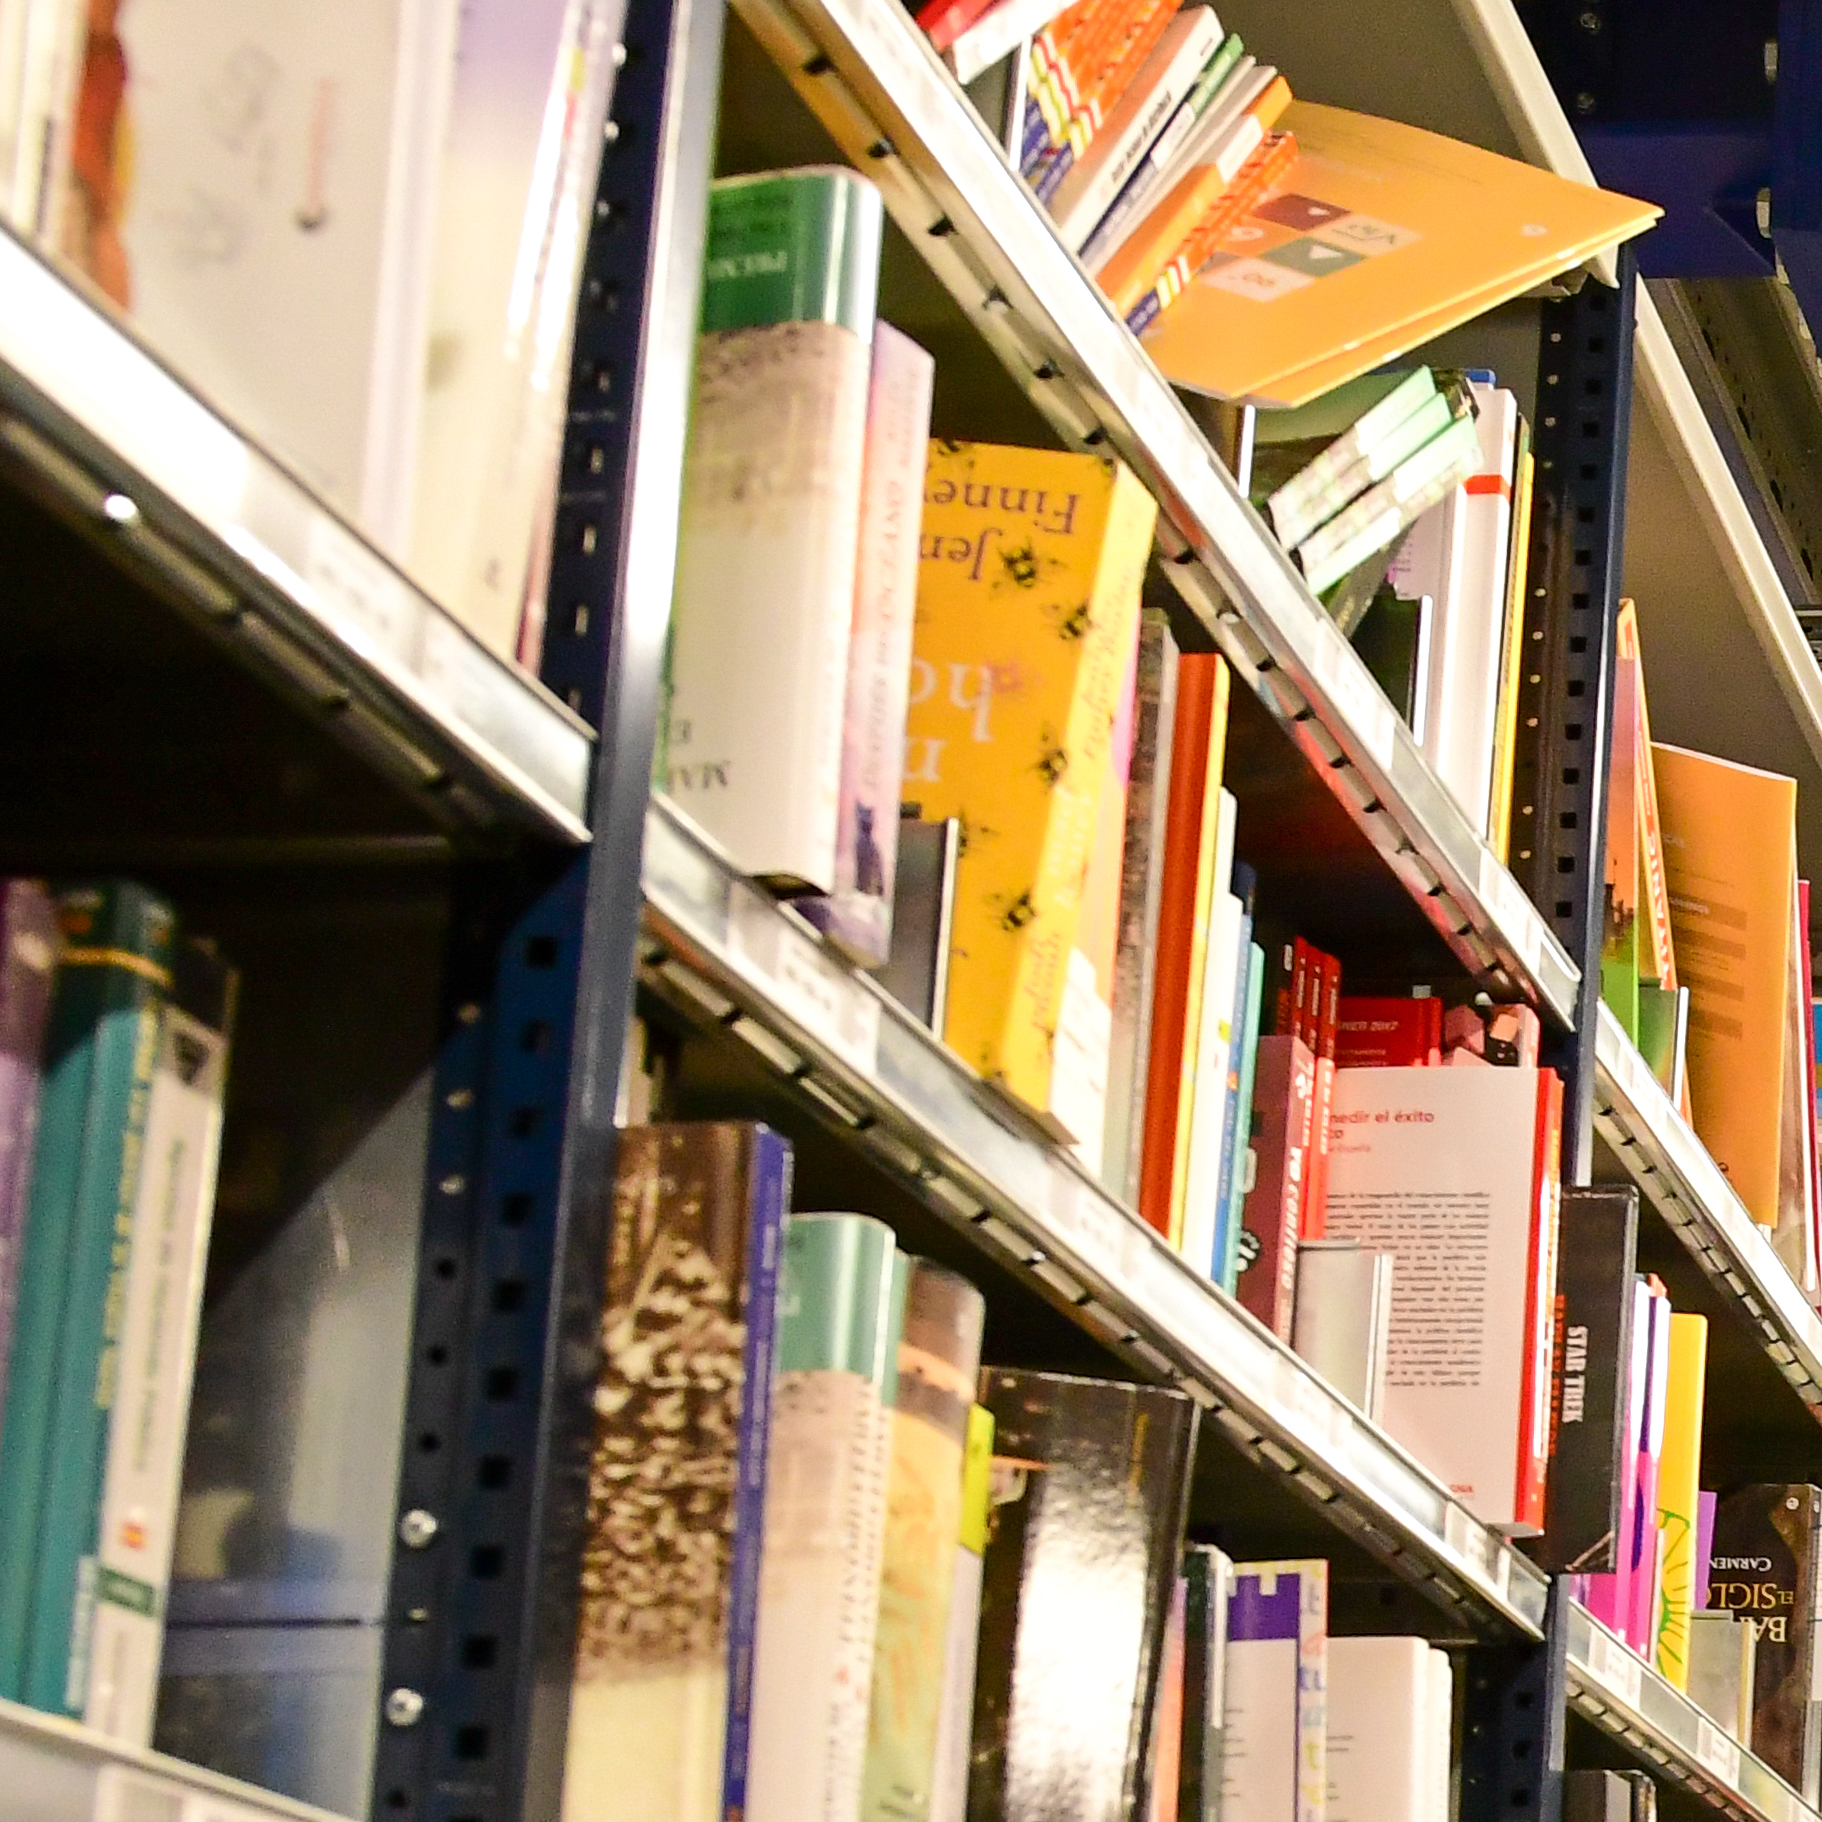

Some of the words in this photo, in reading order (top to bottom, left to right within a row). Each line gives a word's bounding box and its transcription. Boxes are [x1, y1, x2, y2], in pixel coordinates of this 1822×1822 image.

[1394, 1108, 1435, 1124] éxito
[1566, 1326, 1589, 1371] STAR
[1562, 1375, 1586, 1424] TREK
